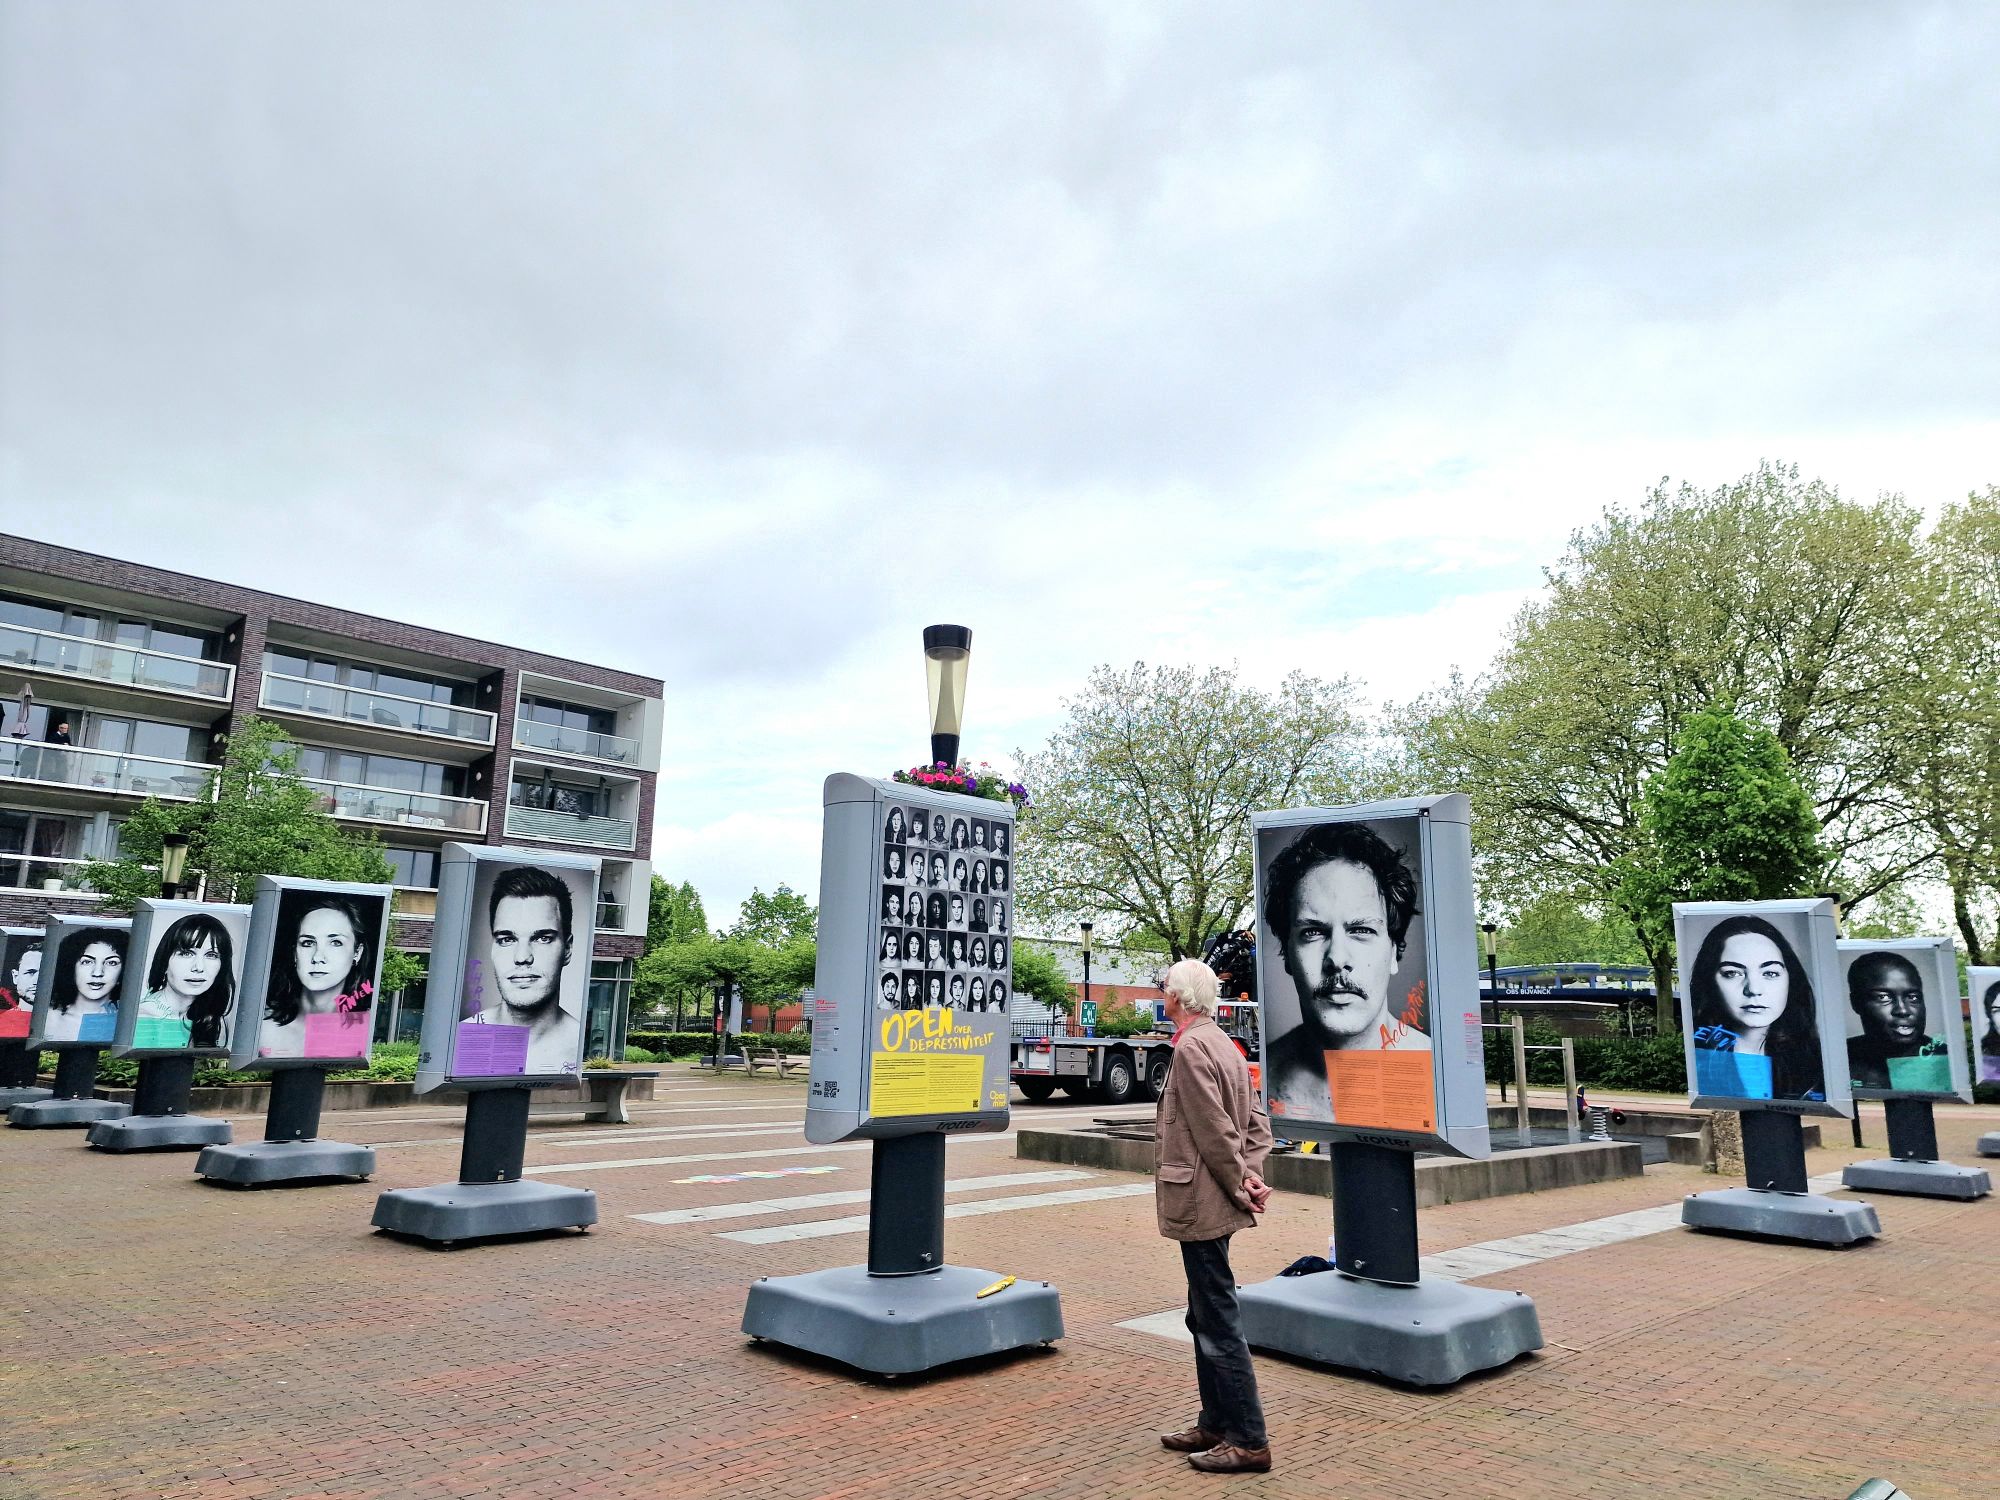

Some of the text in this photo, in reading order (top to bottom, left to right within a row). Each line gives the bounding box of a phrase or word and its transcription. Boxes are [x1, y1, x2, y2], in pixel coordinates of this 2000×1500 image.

[334, 979, 374, 1013] PANIEK
[881, 1007, 953, 1052] OPEN
[954, 1024, 972, 1035] OVER
[909, 1032, 995, 1052] DEPRESSIVITEIT
[936, 1119, 980, 1131] trotter
[1355, 1132, 1411, 1147] trotter
